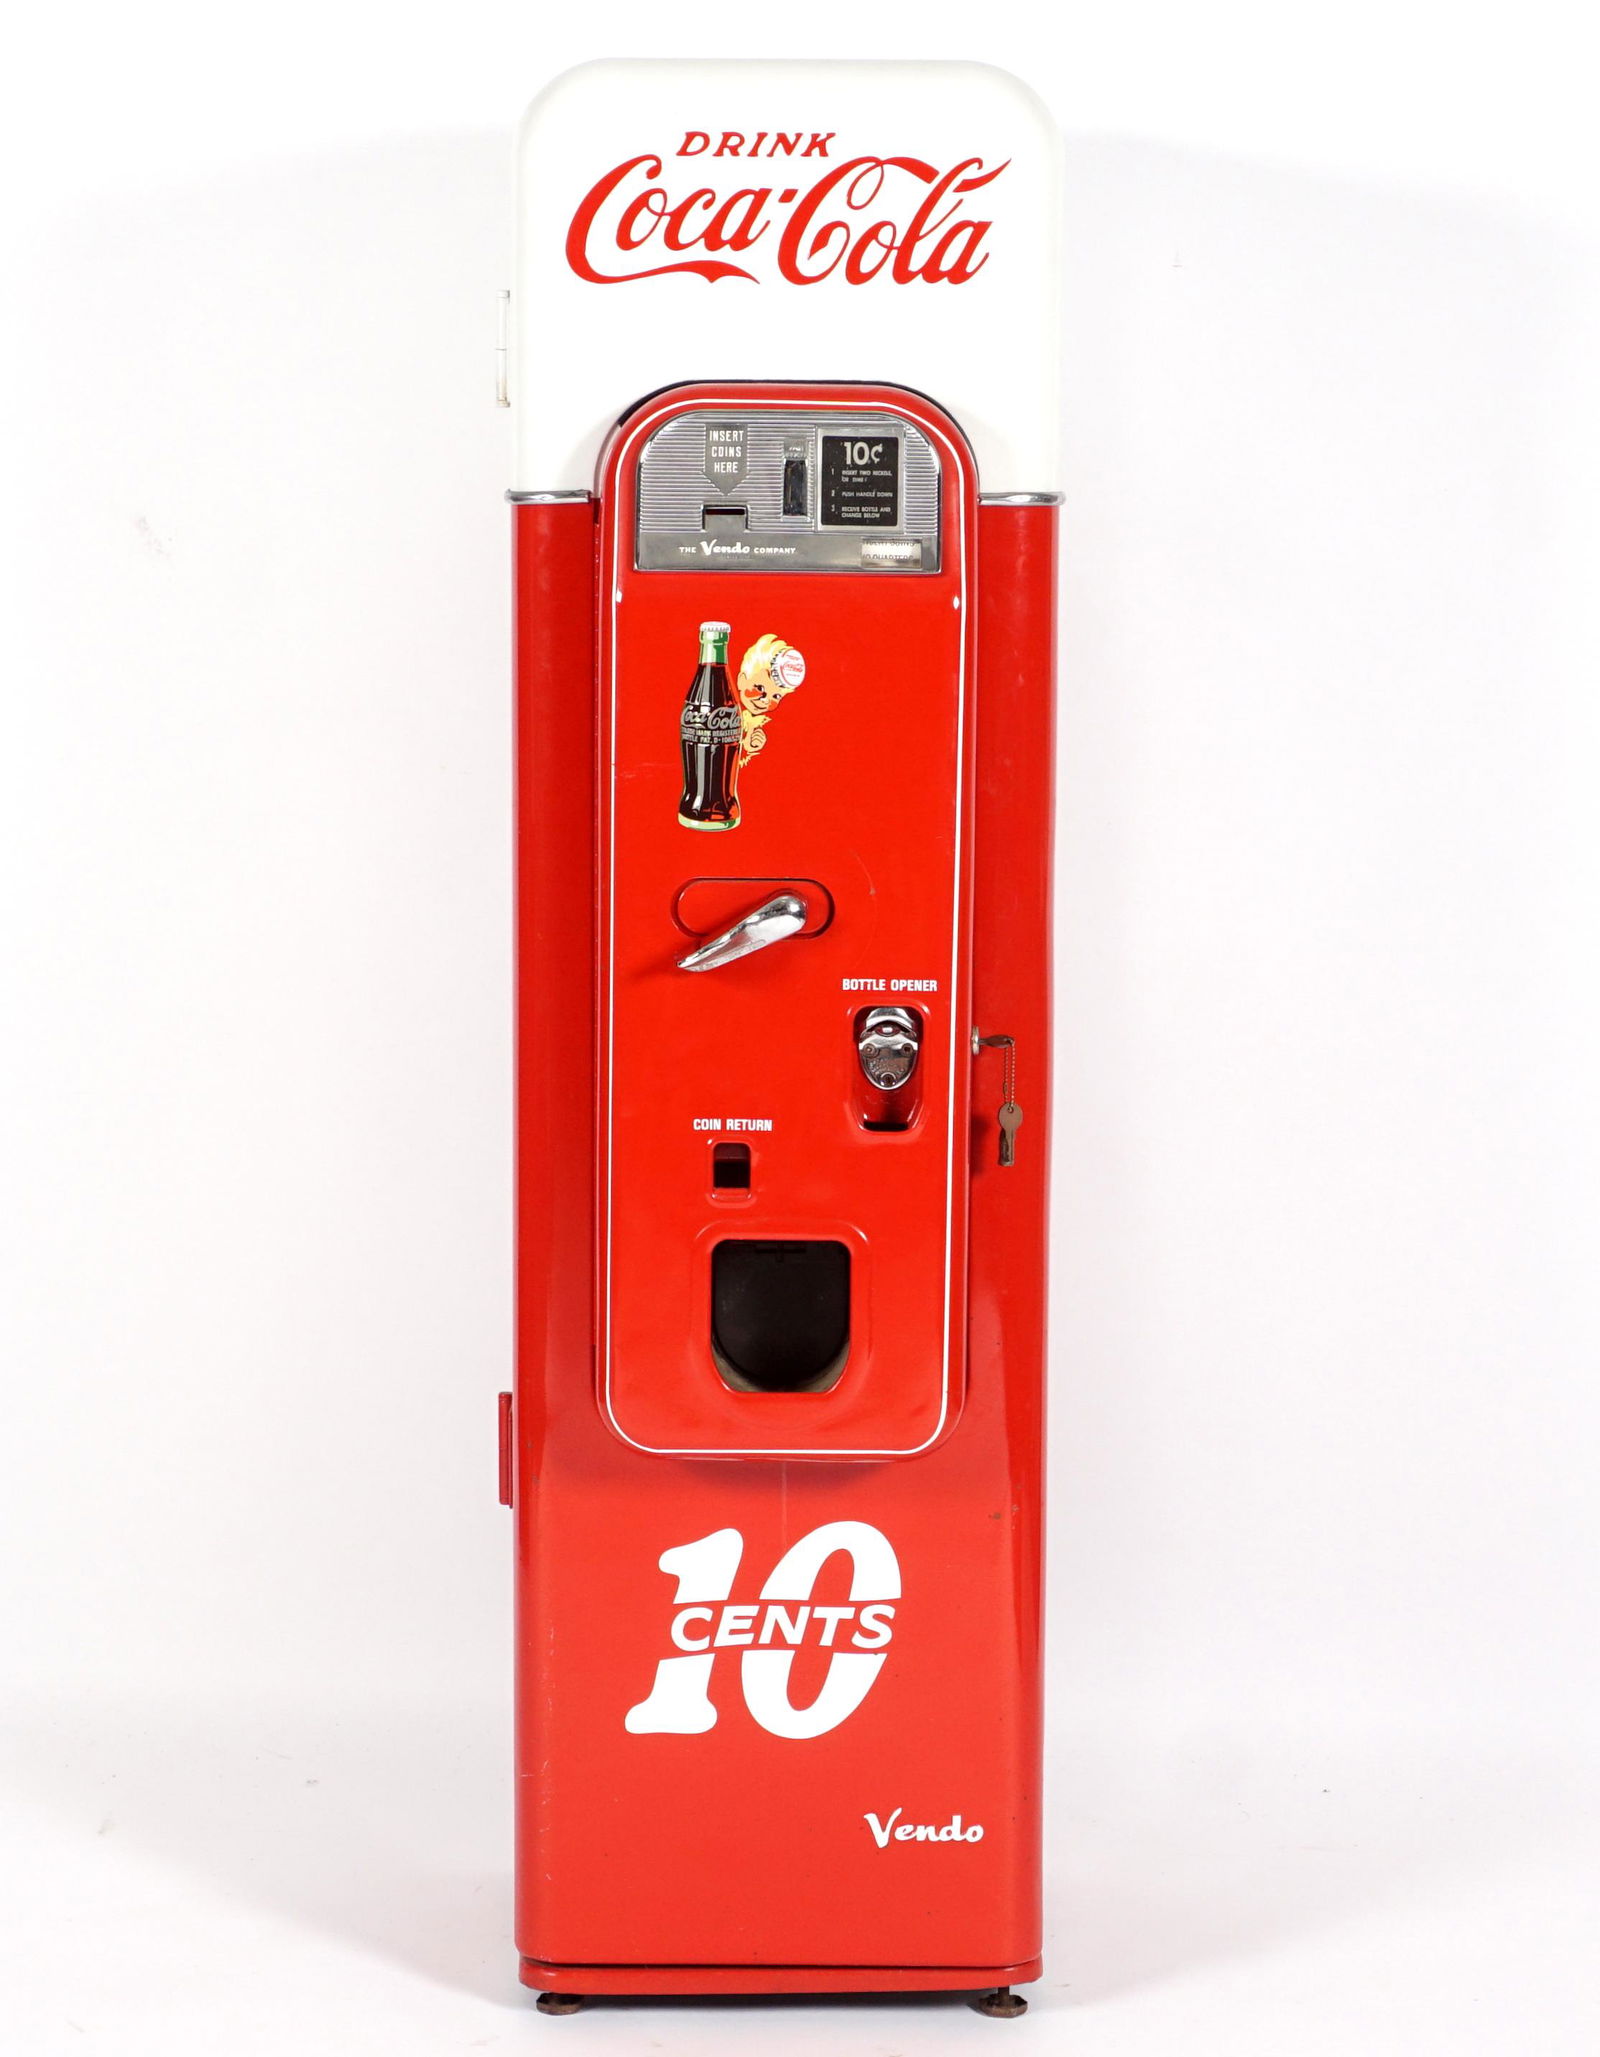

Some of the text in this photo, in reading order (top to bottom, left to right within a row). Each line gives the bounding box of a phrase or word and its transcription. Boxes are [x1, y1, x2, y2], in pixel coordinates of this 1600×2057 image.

[676, 131, 836, 157] DRINK
[565, 155, 1011, 286] Coca-Cola
[709, 430, 744, 442] INSERT
[711, 446, 742, 458] COINS
[844, 441, 883, 466] 10¢
[714, 461, 739, 473] HERE
[700, 539, 751, 556] Vendo
[842, 979, 938, 992] BOTTLE OPENER
[693, 1118, 773, 1132] COIN RETURN
[625, 1521, 901, 1740] 10
[670, 1604, 896, 1652] CENTS
[864, 1808, 984, 1849] Vendo
